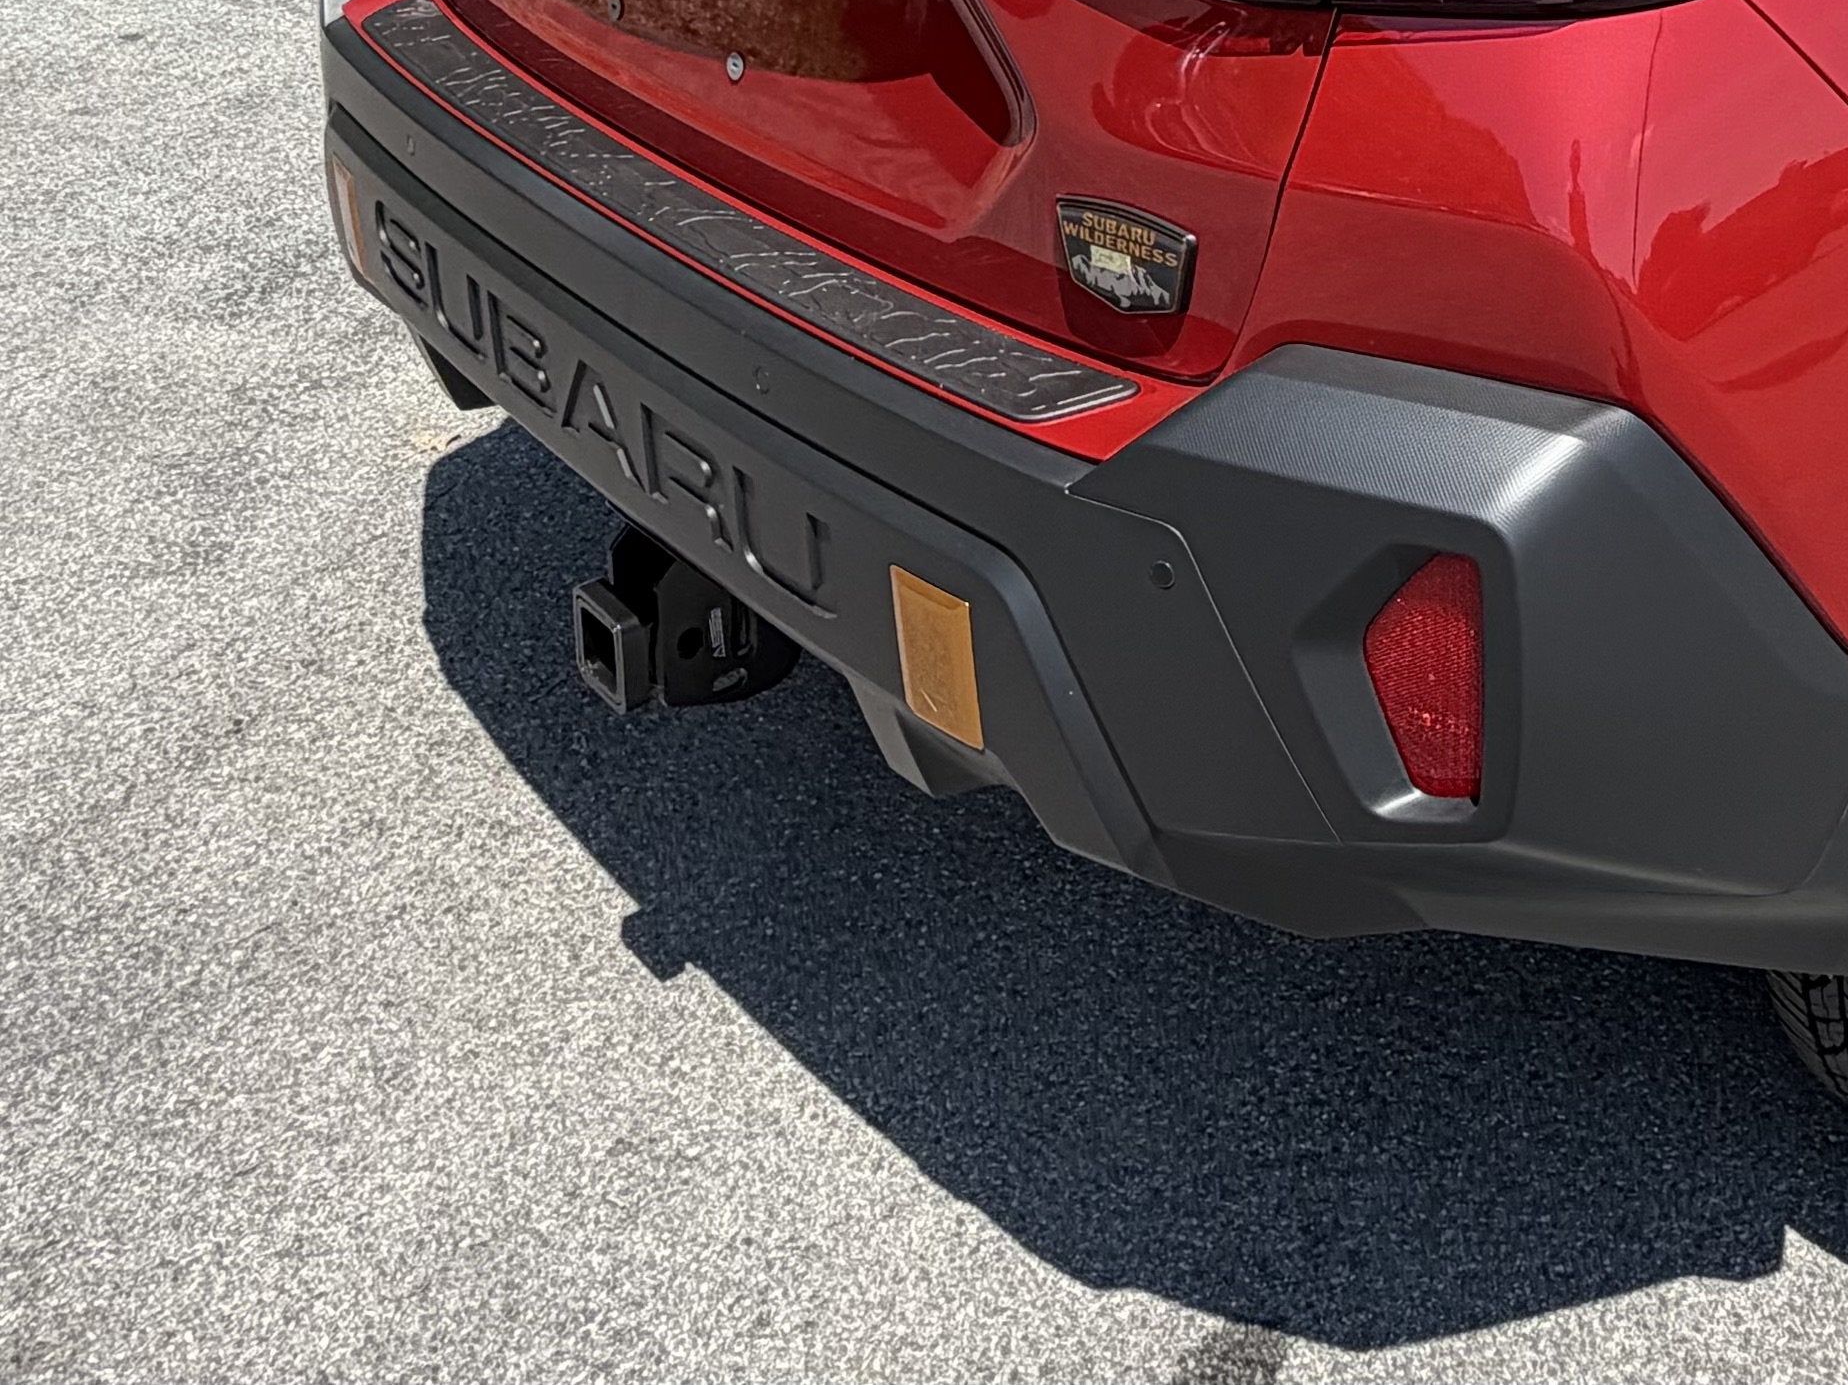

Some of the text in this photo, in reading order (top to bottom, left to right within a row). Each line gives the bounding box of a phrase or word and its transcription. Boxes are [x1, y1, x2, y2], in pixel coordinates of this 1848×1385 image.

[1064, 221, 1178, 267] WILDERNESS
[1082, 213, 1156, 245] SUBARU
[374, 199, 838, 619] SUBARU
